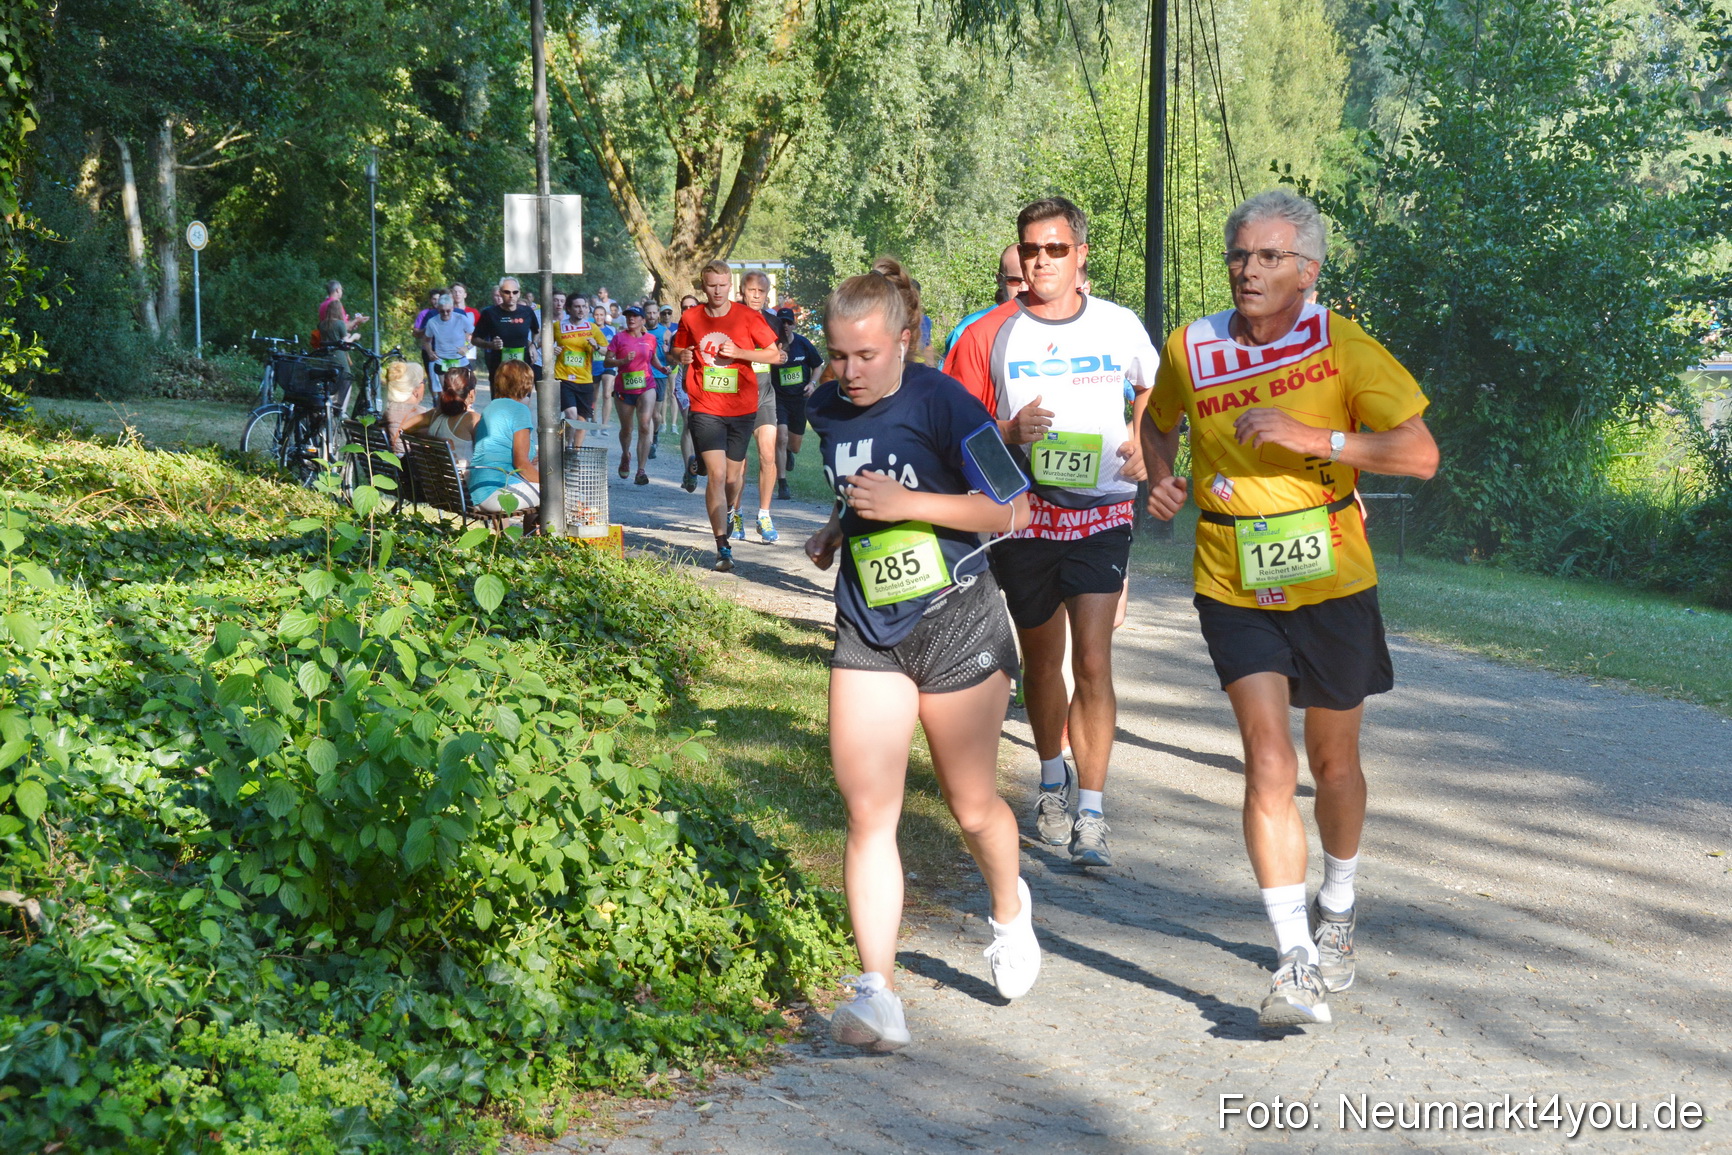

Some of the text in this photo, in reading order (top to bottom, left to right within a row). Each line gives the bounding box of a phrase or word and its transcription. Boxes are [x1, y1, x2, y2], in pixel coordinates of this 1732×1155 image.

[566, 355, 583, 363] 1202
[1008, 344, 1121, 379] RÖDL
[625, 376, 643, 385] 2068
[710, 376, 730, 387] 779
[783, 372, 801, 381] 1085
[1196, 386, 1260, 419] MAX
[1269, 359, 1339, 397] BÖGL
[1041, 450, 1091, 472] 1751
[1057, 508, 1102, 527] AVIA
[1251, 535, 1321, 568] 1243
[870, 550, 921, 584] 285
[1259, 561, 1318, 576] Reichert Michael
[874, 573, 930, 593] Schönfeld Svenja
